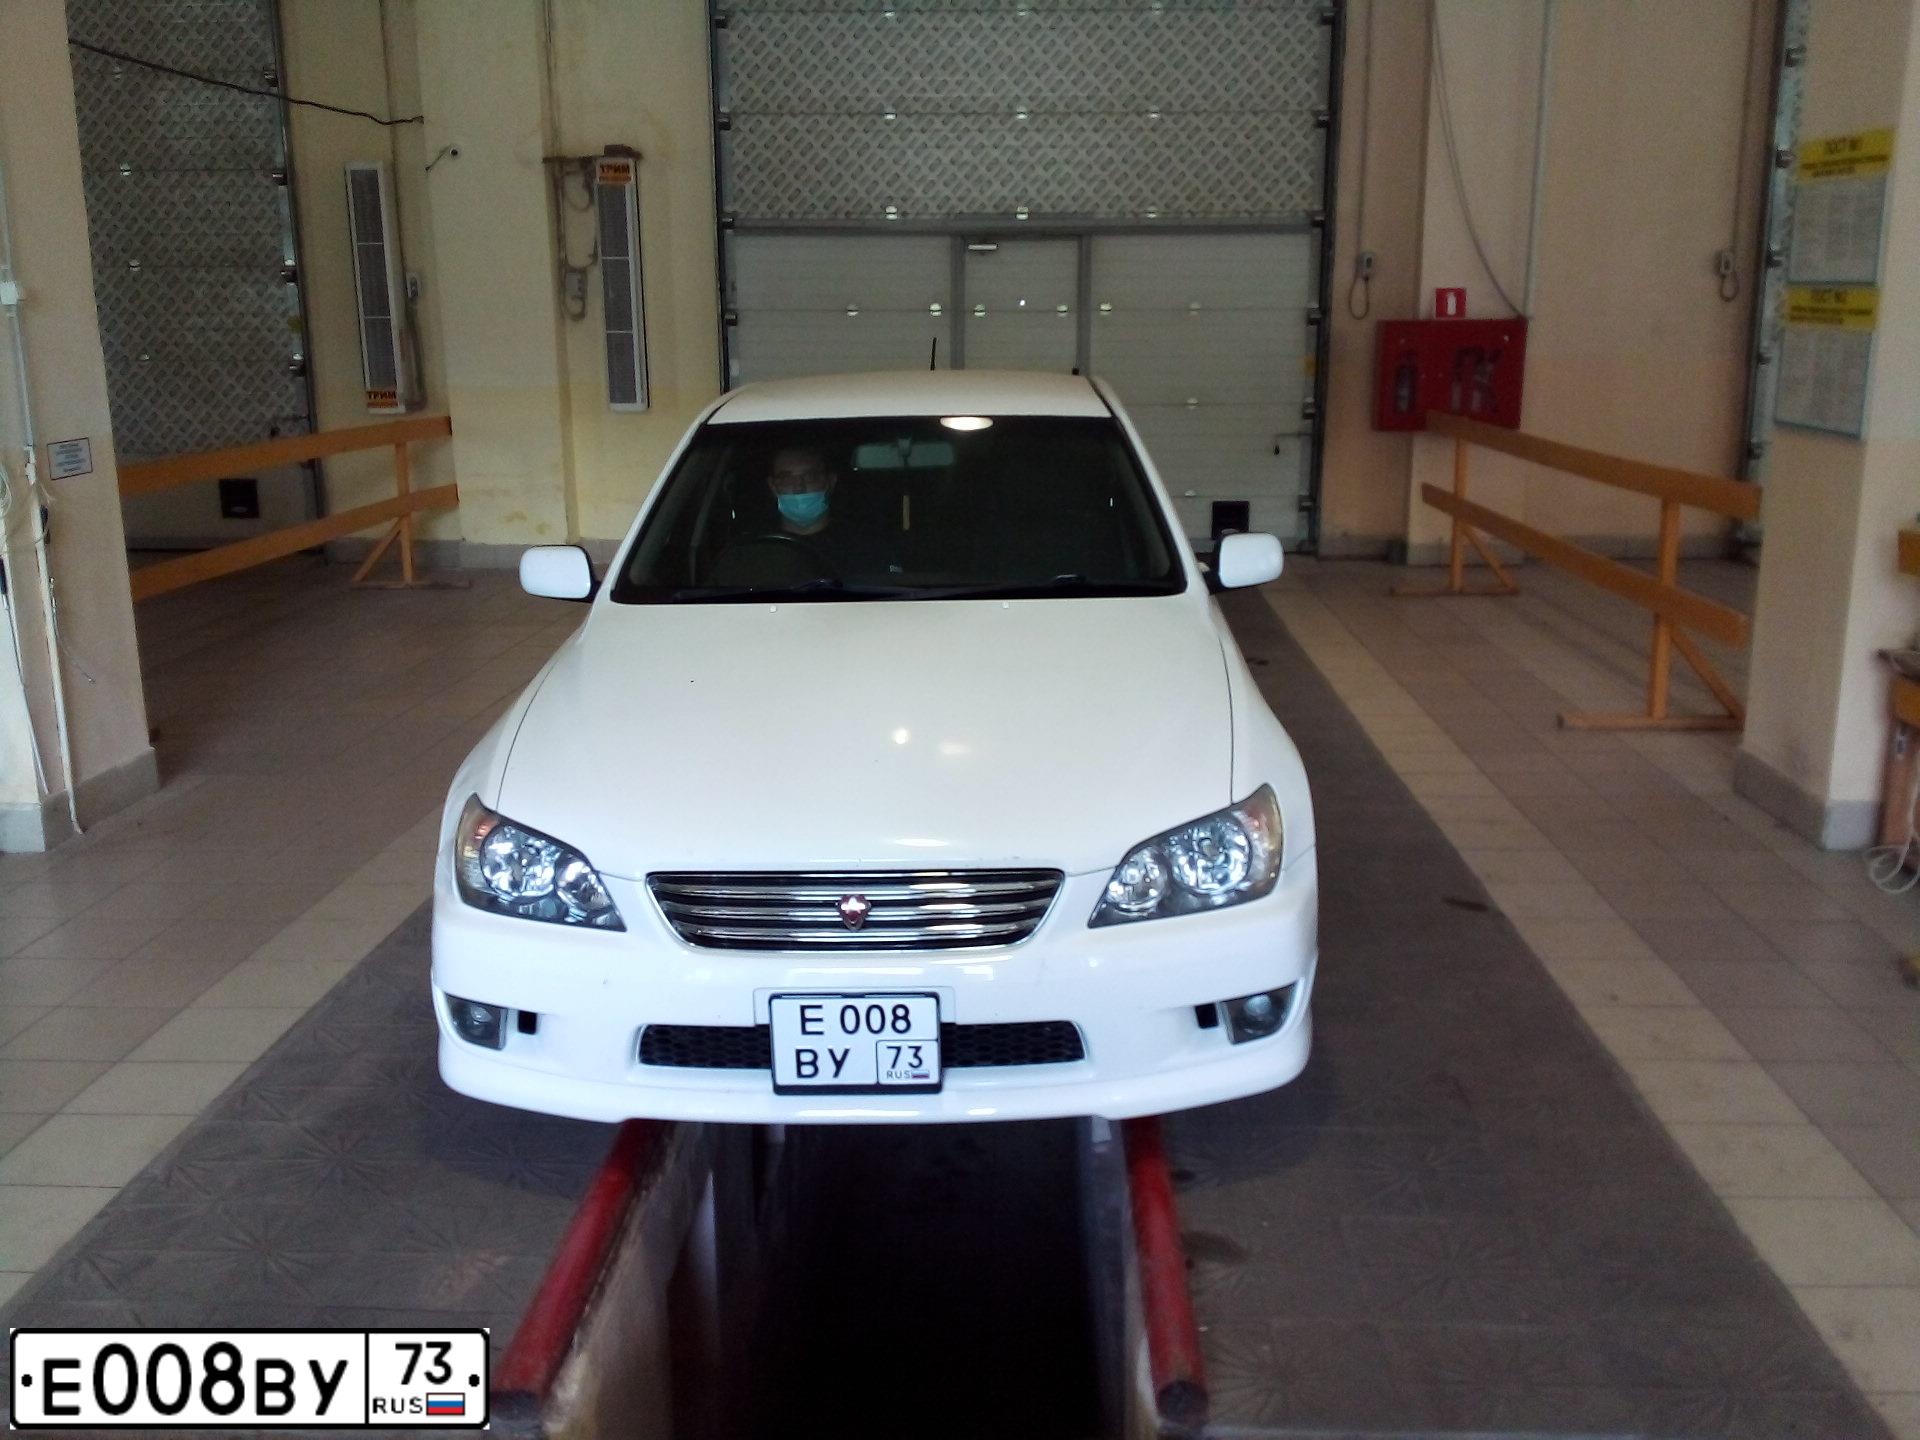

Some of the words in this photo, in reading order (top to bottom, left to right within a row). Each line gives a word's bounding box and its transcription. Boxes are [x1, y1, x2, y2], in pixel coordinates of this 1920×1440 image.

[839, 1003, 912, 1035] 008
[886, 1045, 924, 1069] 73
[886, 1071, 911, 1079] RUS
